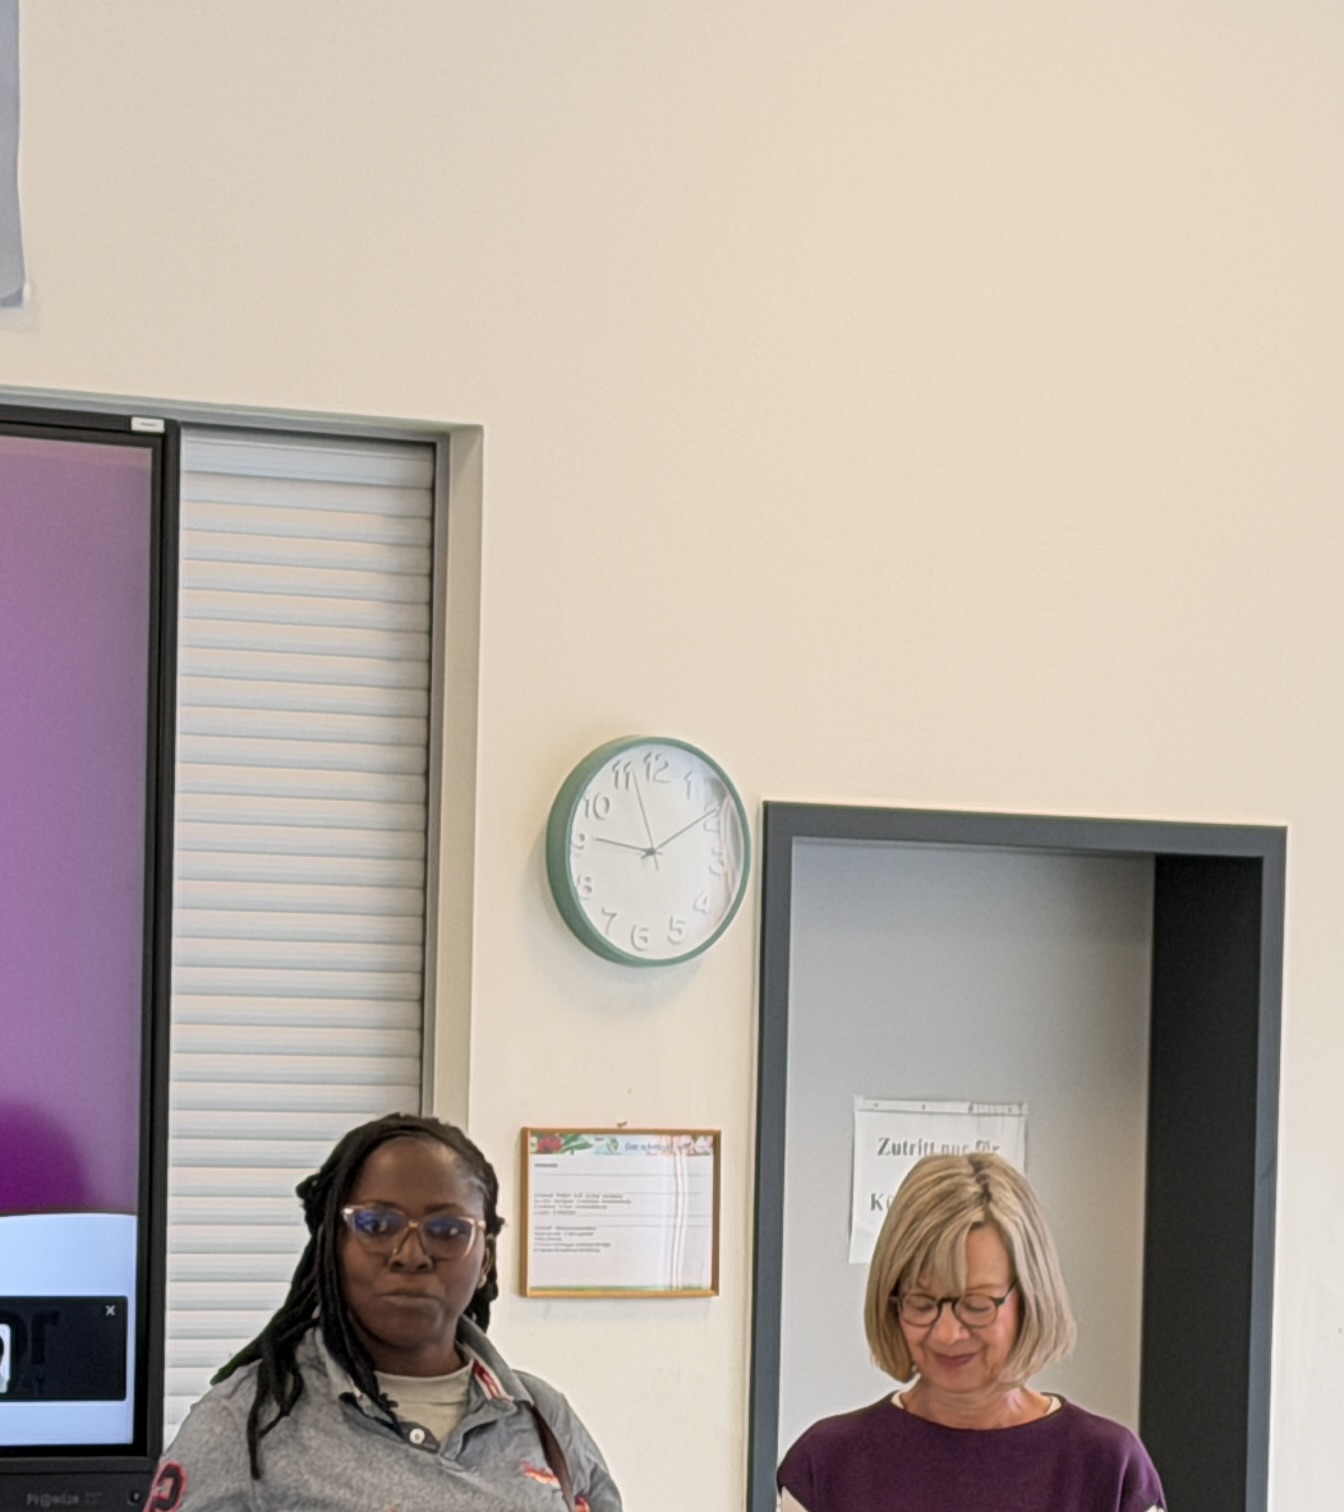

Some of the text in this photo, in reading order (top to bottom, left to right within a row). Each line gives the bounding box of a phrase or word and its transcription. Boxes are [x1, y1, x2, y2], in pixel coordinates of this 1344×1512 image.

[611, 759, 633, 792] 11
[643, 751, 671, 784] 12
[683, 769, 693, 800] 1
[582, 792, 611, 821] 10
[577, 874, 593, 901] 8
[692, 891, 711, 916] 4
[600, 906, 618, 936] 7
[666, 915, 686, 946] 5
[629, 923, 650, 951] 6
[876, 1137, 936, 1156] Zutritt
